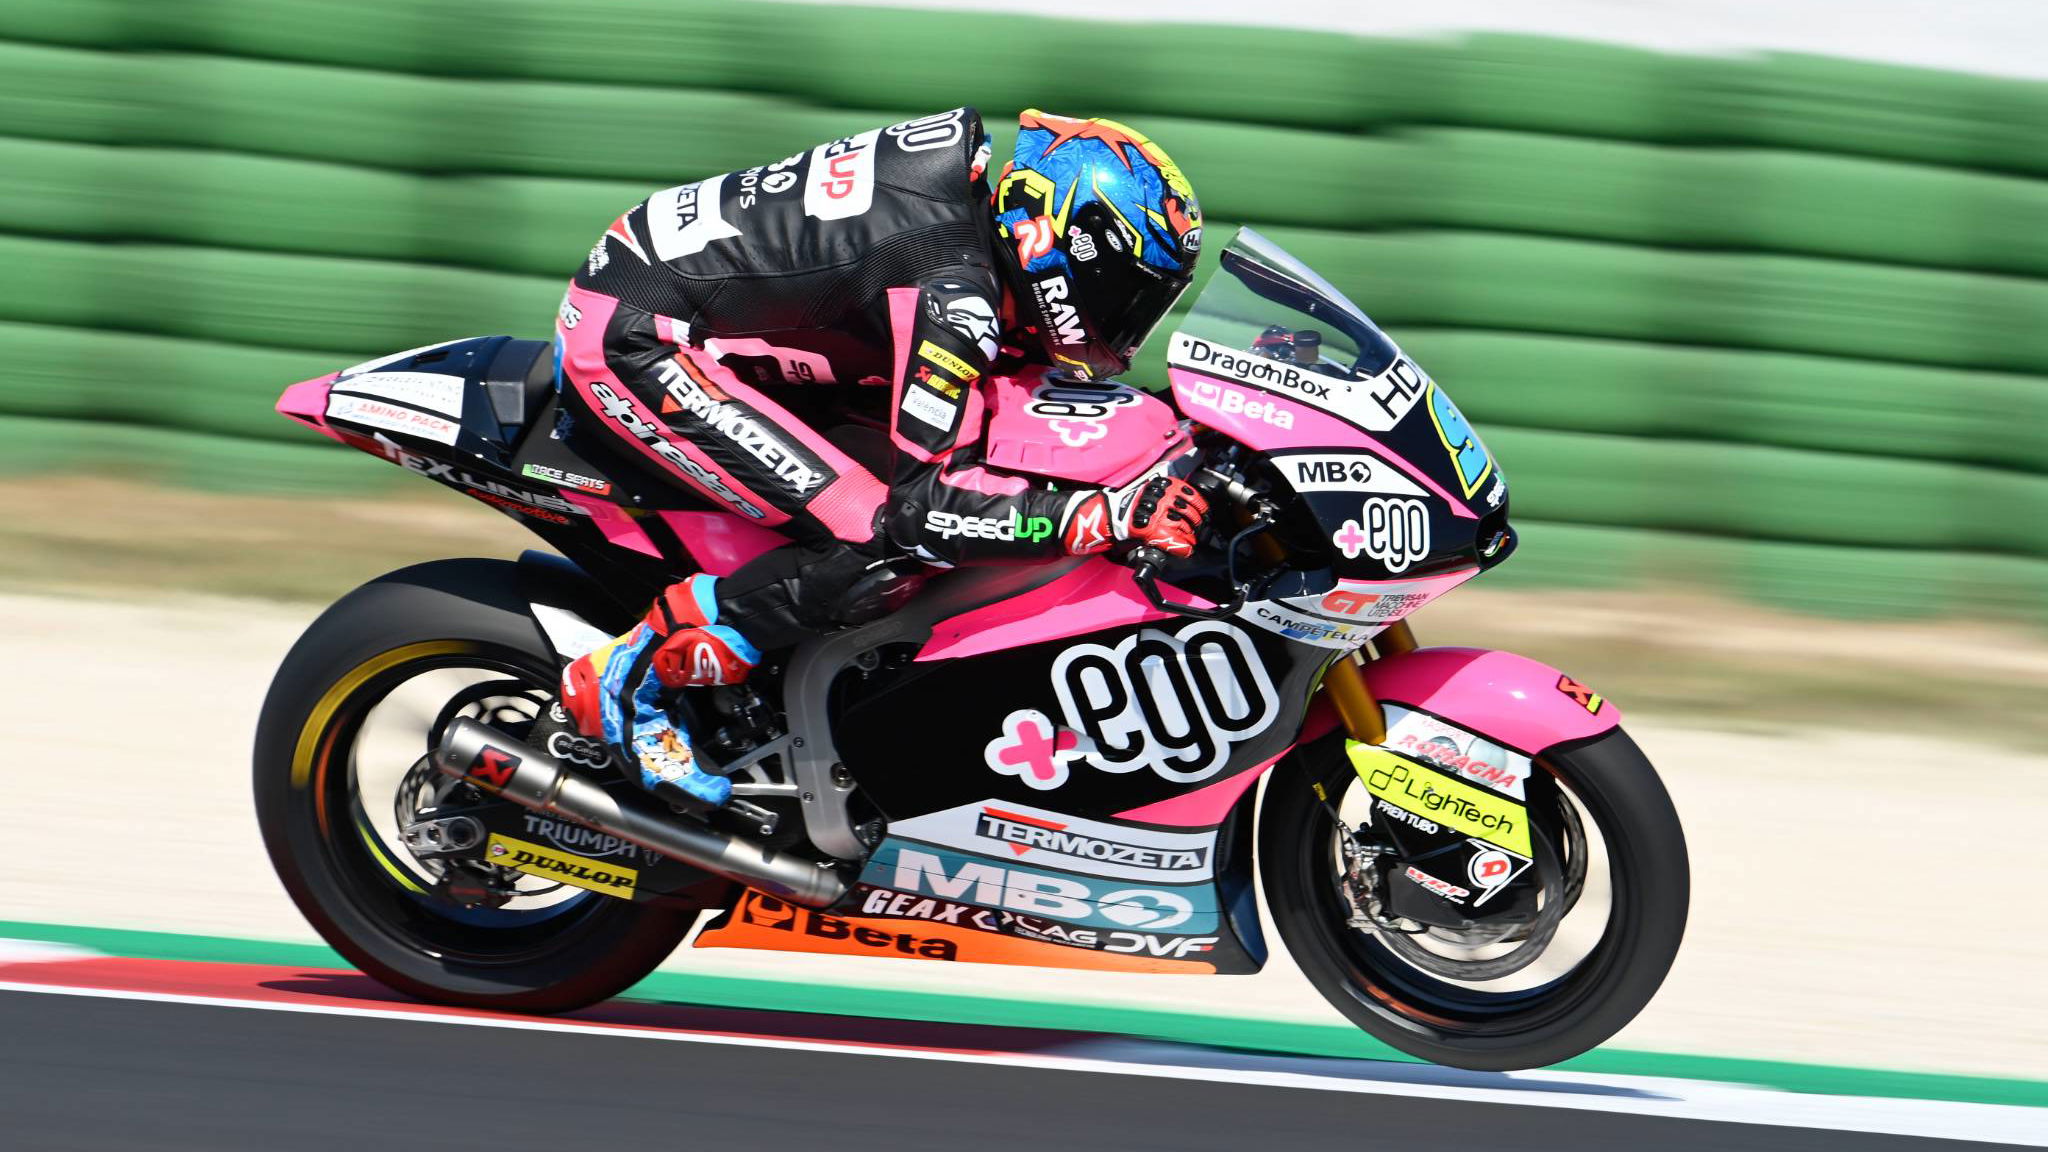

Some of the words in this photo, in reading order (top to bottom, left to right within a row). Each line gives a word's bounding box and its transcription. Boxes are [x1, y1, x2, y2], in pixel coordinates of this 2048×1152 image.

[1040, 275, 1088, 345] RAW
[932, 351, 976, 379] DUNLOP
[1188, 340, 1331, 401] DragonBox
[656, 358, 818, 494] TERMOZETA
[1220, 390, 1296, 430] Beta
[590, 381, 766, 518] alpinestars
[531, 464, 564, 480] RACE
[565, 472, 606, 490] SEATS
[1256, 607, 1369, 641] CAMPETELLA
[1321, 590, 1381, 615] GT
[1398, 734, 1517, 788] ROMAGNA
[1403, 777, 1514, 834] LighTech
[523, 815, 637, 858] TRIUMPH
[981, 814, 1205, 869] TERMOZETA
[511, 850, 633, 888] DUNLOP
[862, 889, 970, 923] GEAX
[804, 912, 958, 961] Beta
